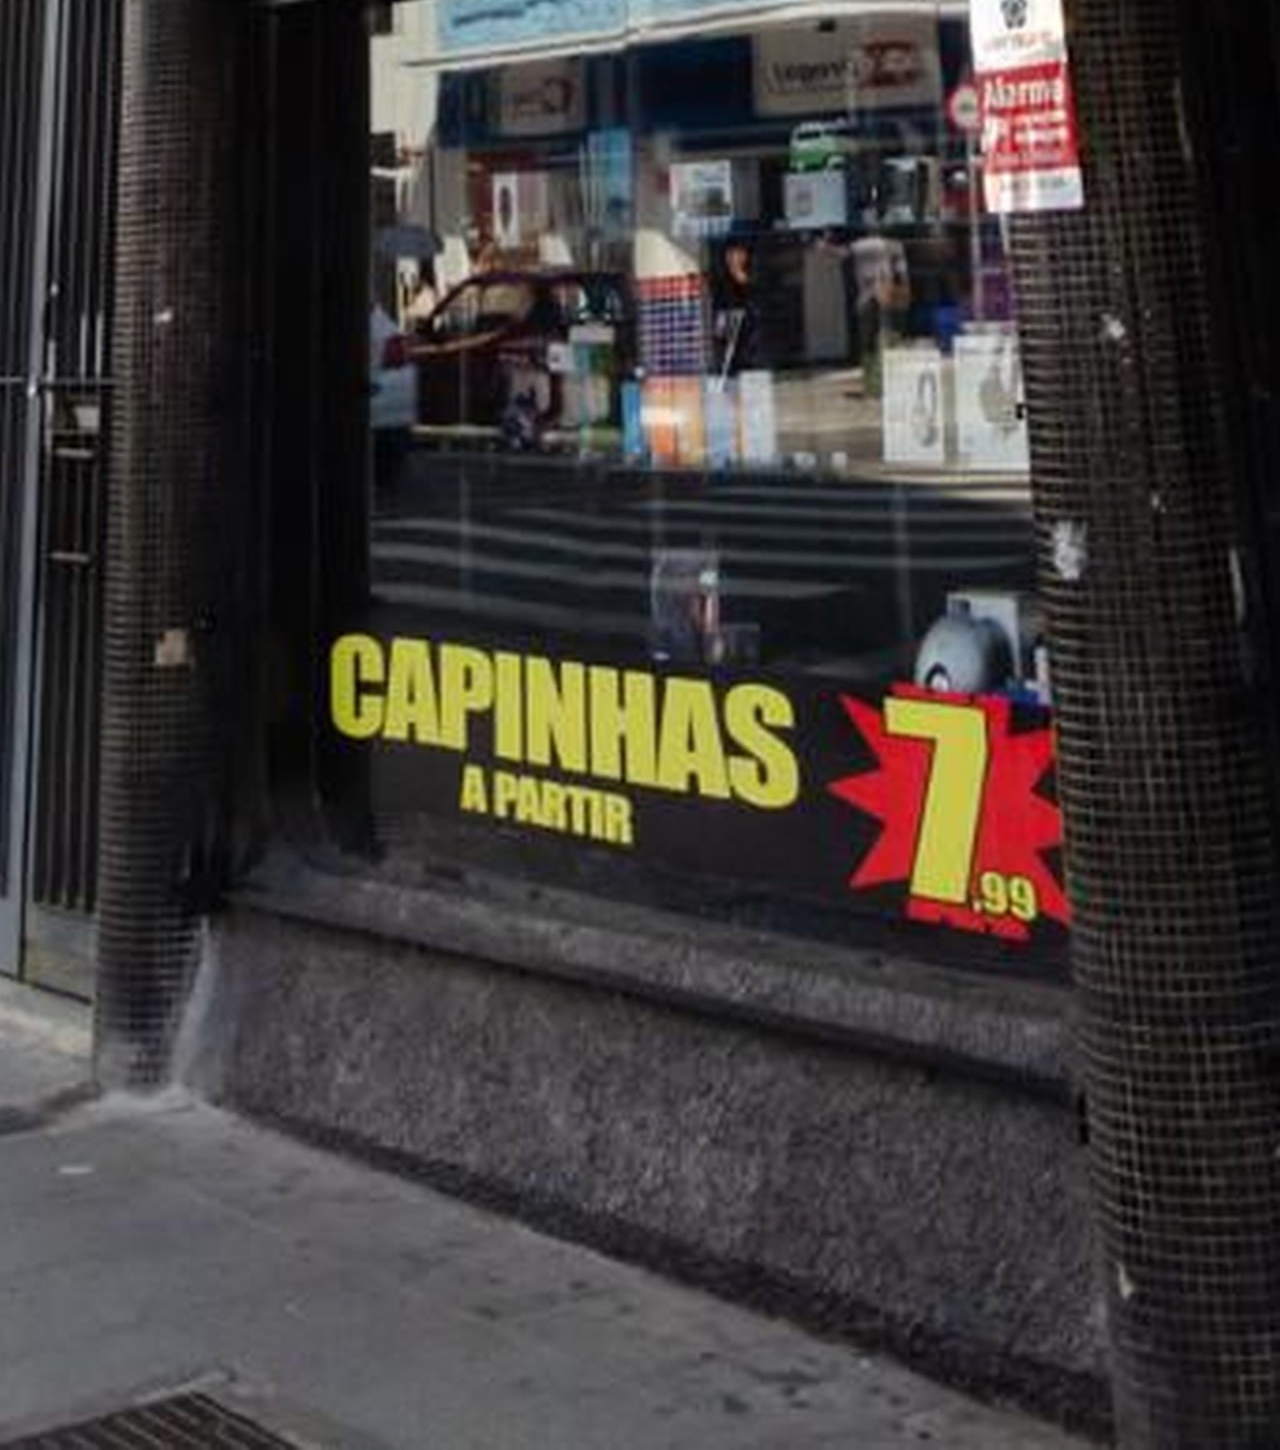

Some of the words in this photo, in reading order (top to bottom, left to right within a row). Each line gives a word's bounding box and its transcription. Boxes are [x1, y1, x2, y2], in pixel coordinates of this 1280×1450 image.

[330, 634, 799, 809] CAPINHAS
[459, 768, 488, 816] A
[493, 774, 634, 845] PARTIR
